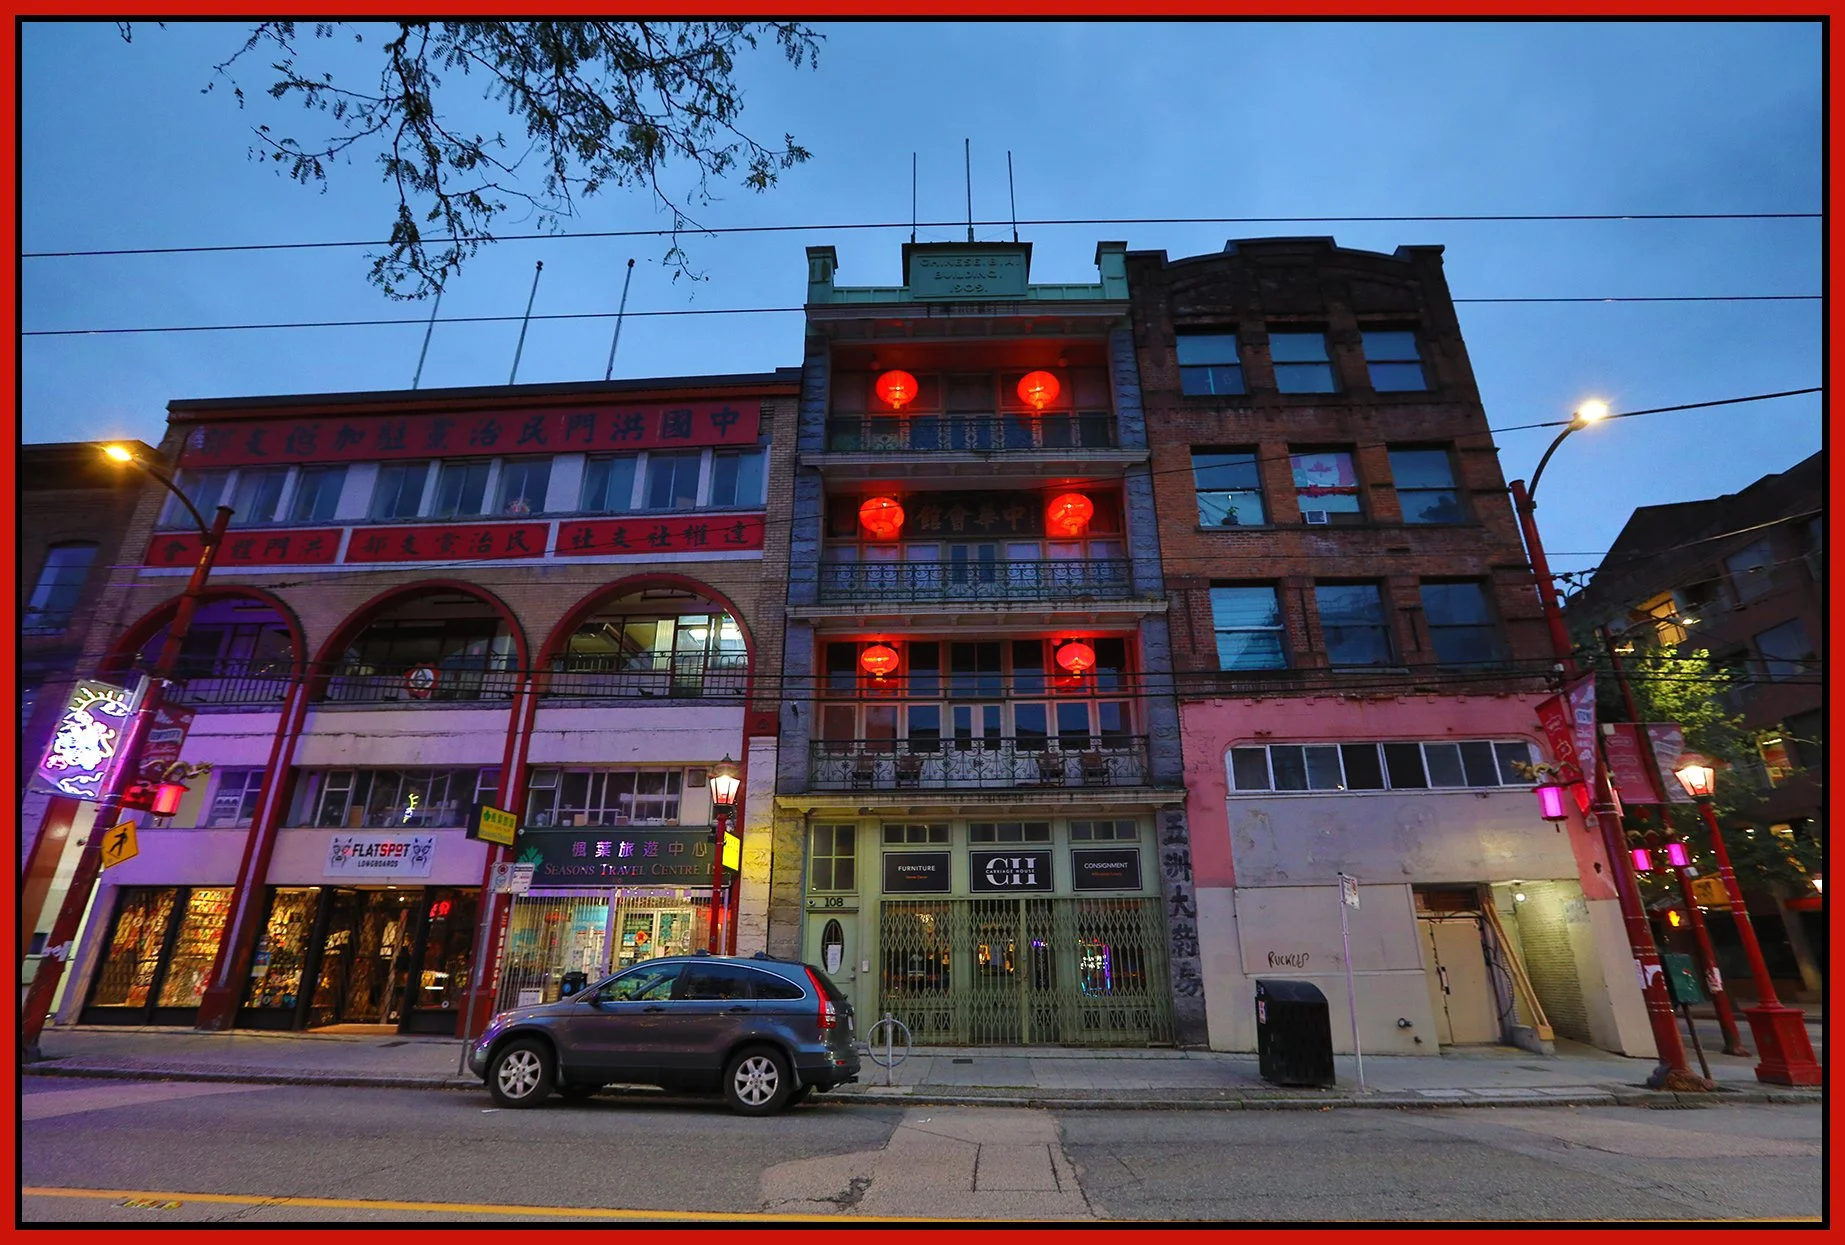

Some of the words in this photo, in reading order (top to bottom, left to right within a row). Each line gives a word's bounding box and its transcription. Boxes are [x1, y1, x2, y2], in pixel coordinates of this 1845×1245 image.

[164, 536, 323, 562] 洪門體會
[352, 843, 410, 858] FLATSPOT
[358, 860, 398, 868] LONGBOARDS
[651, 863, 701, 876] CENTRE
[986, 857, 1037, 886] CH
[824, 897, 844, 907] 108
